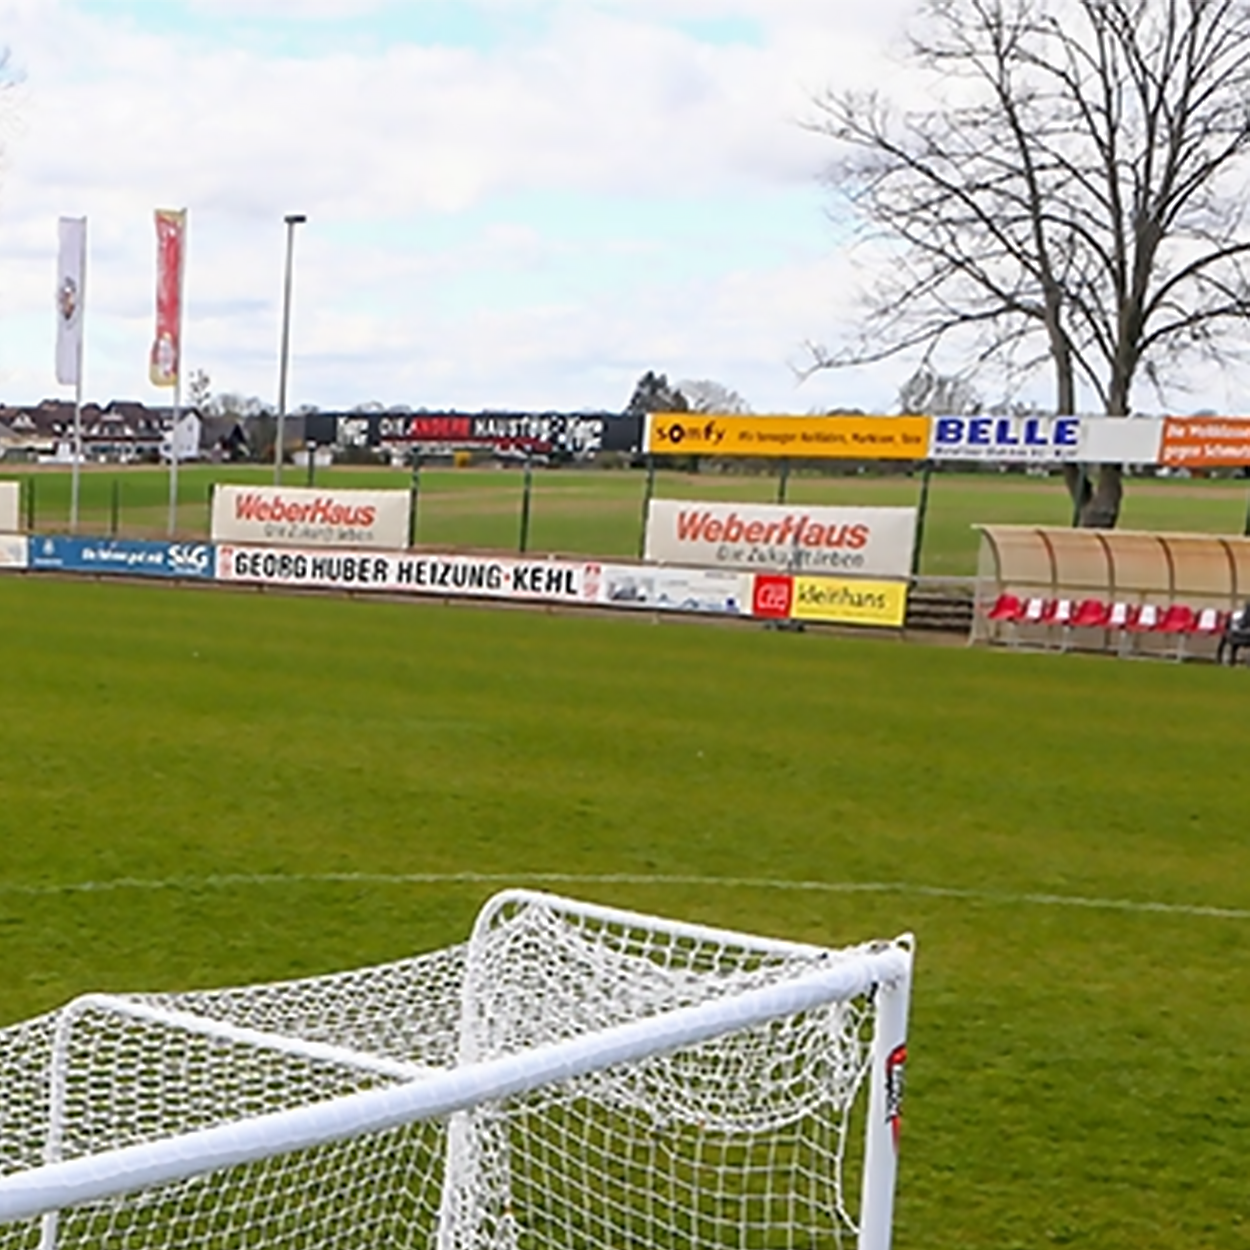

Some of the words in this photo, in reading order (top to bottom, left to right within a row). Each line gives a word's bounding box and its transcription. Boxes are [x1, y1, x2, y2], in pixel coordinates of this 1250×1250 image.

[656, 421, 726, 445] somfy
[935, 418, 1080, 445] BELLE
[235, 494, 377, 528] WeberHaus
[676, 511, 870, 549] WeberHaus
[235, 552, 307, 579] GEORG
[311, 556, 389, 583] HUBER
[397, 560, 501, 590] HEIZUNG
[512, 565, 578, 595] KEHL
